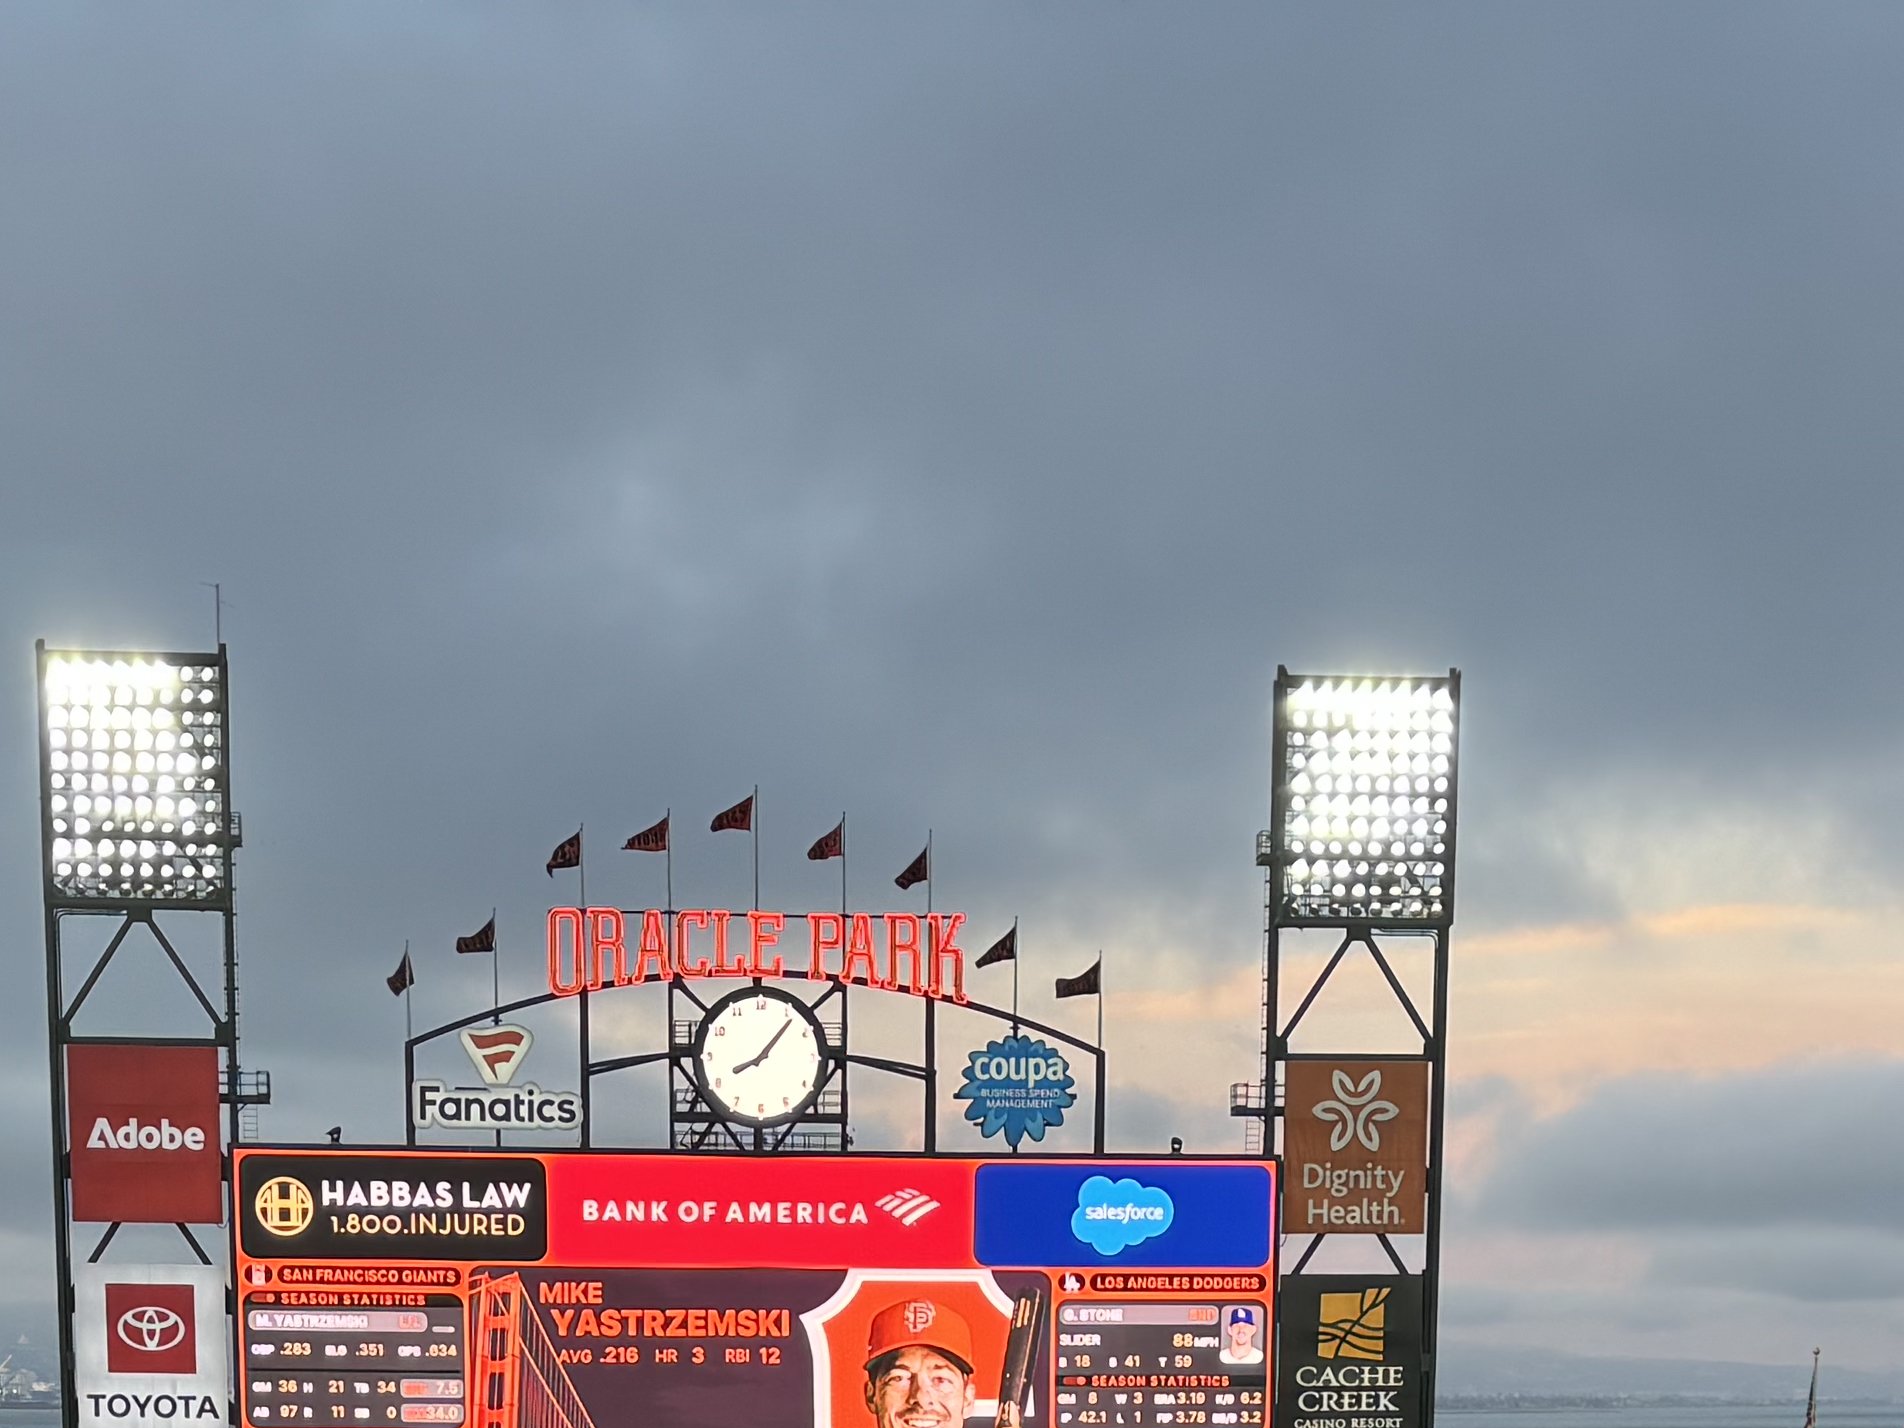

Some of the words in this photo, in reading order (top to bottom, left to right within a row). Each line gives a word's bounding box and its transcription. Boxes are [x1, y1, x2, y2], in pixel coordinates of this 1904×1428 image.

[548, 906, 785, 996] ORACLE
[807, 910, 968, 1004] PARK
[974, 1052, 1064, 1083] coupa
[419, 1085, 577, 1124] Fanatics
[980, 1088, 1027, 1099] BUSINESS
[1029, 1088, 1060, 1099] SPEND
[986, 1099, 1054, 1110] MANAGEMENT
[86, 1117, 206, 1151] Adobe
[1303, 1163, 1405, 1197] Dignity
[321, 1179, 454, 1208] HABBAS
[461, 1181, 532, 1209] LAW
[583, 1199, 668, 1223] BANK
[676, 1200, 718, 1223] OF
[725, 1201, 869, 1225] AMERICA
[1084, 1202, 1165, 1223] salesforce
[331, 1212, 526, 1237] 1.800.INJURED
[282, 1268, 314, 1282] SAN
[315, 1269, 399, 1283] FRANCISCO
[401, 1269, 457, 1284] GIANTS
[1096, 1276, 1124, 1290] LOS
[1127, 1276, 1190, 1290] ANGELES
[1193, 1277, 1260, 1290] DODGERS
[280, 1292, 338, 1305] SEASON
[343, 1293, 426, 1306] STATISTICS
[539, 1282, 603, 1304] MIKE
[550, 1308, 790, 1337] YASTRZEMSKI
[558, 1350, 592, 1363] AVG
[599, 1346, 639, 1364] .216
[655, 1349, 677, 1363] HR
[691, 1347, 705, 1364] 3
[725, 1349, 750, 1363] RBI
[759, 1347, 781, 1364] 12
[1091, 1375, 1146, 1387] SEASON
[1150, 1376, 1230, 1387] STATISTICS
[1296, 1366, 1403, 1388] CACHE
[86, 1393, 220, 1420] TOYOTA
[1298, 1390, 1400, 1413] CREEK
